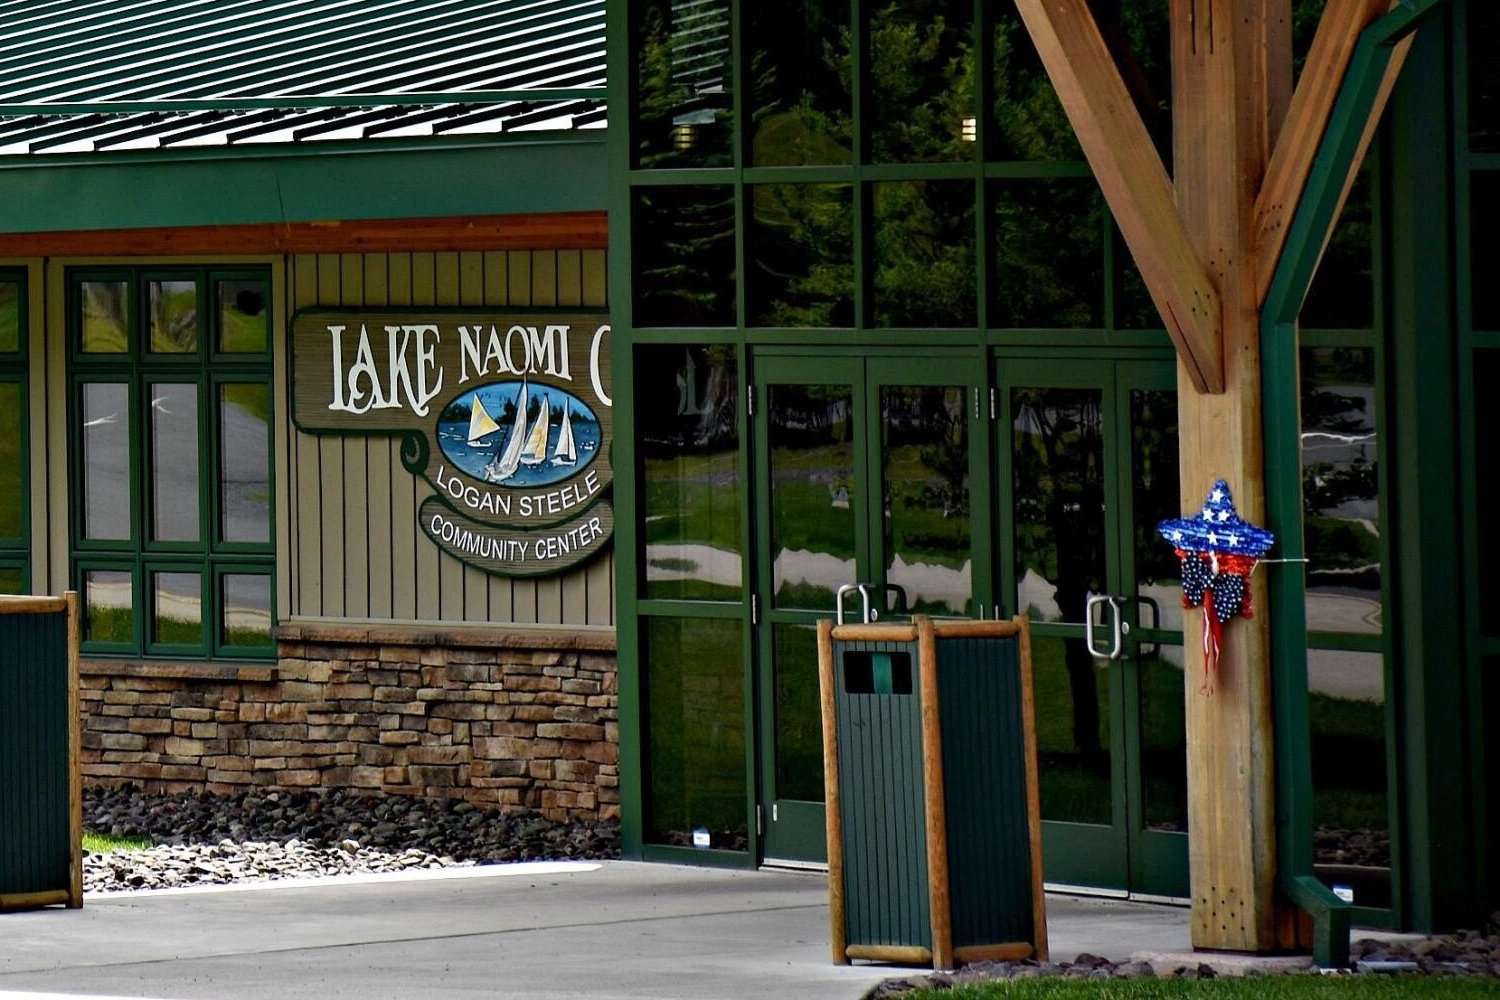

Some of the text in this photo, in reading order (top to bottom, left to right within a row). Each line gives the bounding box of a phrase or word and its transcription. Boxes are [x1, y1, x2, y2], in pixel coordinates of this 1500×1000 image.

[327, 324, 443, 417] LAKE
[458, 325, 572, 384] NAOMI
[436, 465, 601, 516] LOGAN STEELE
[431, 514, 603, 562] COMMUNITY CENTER
